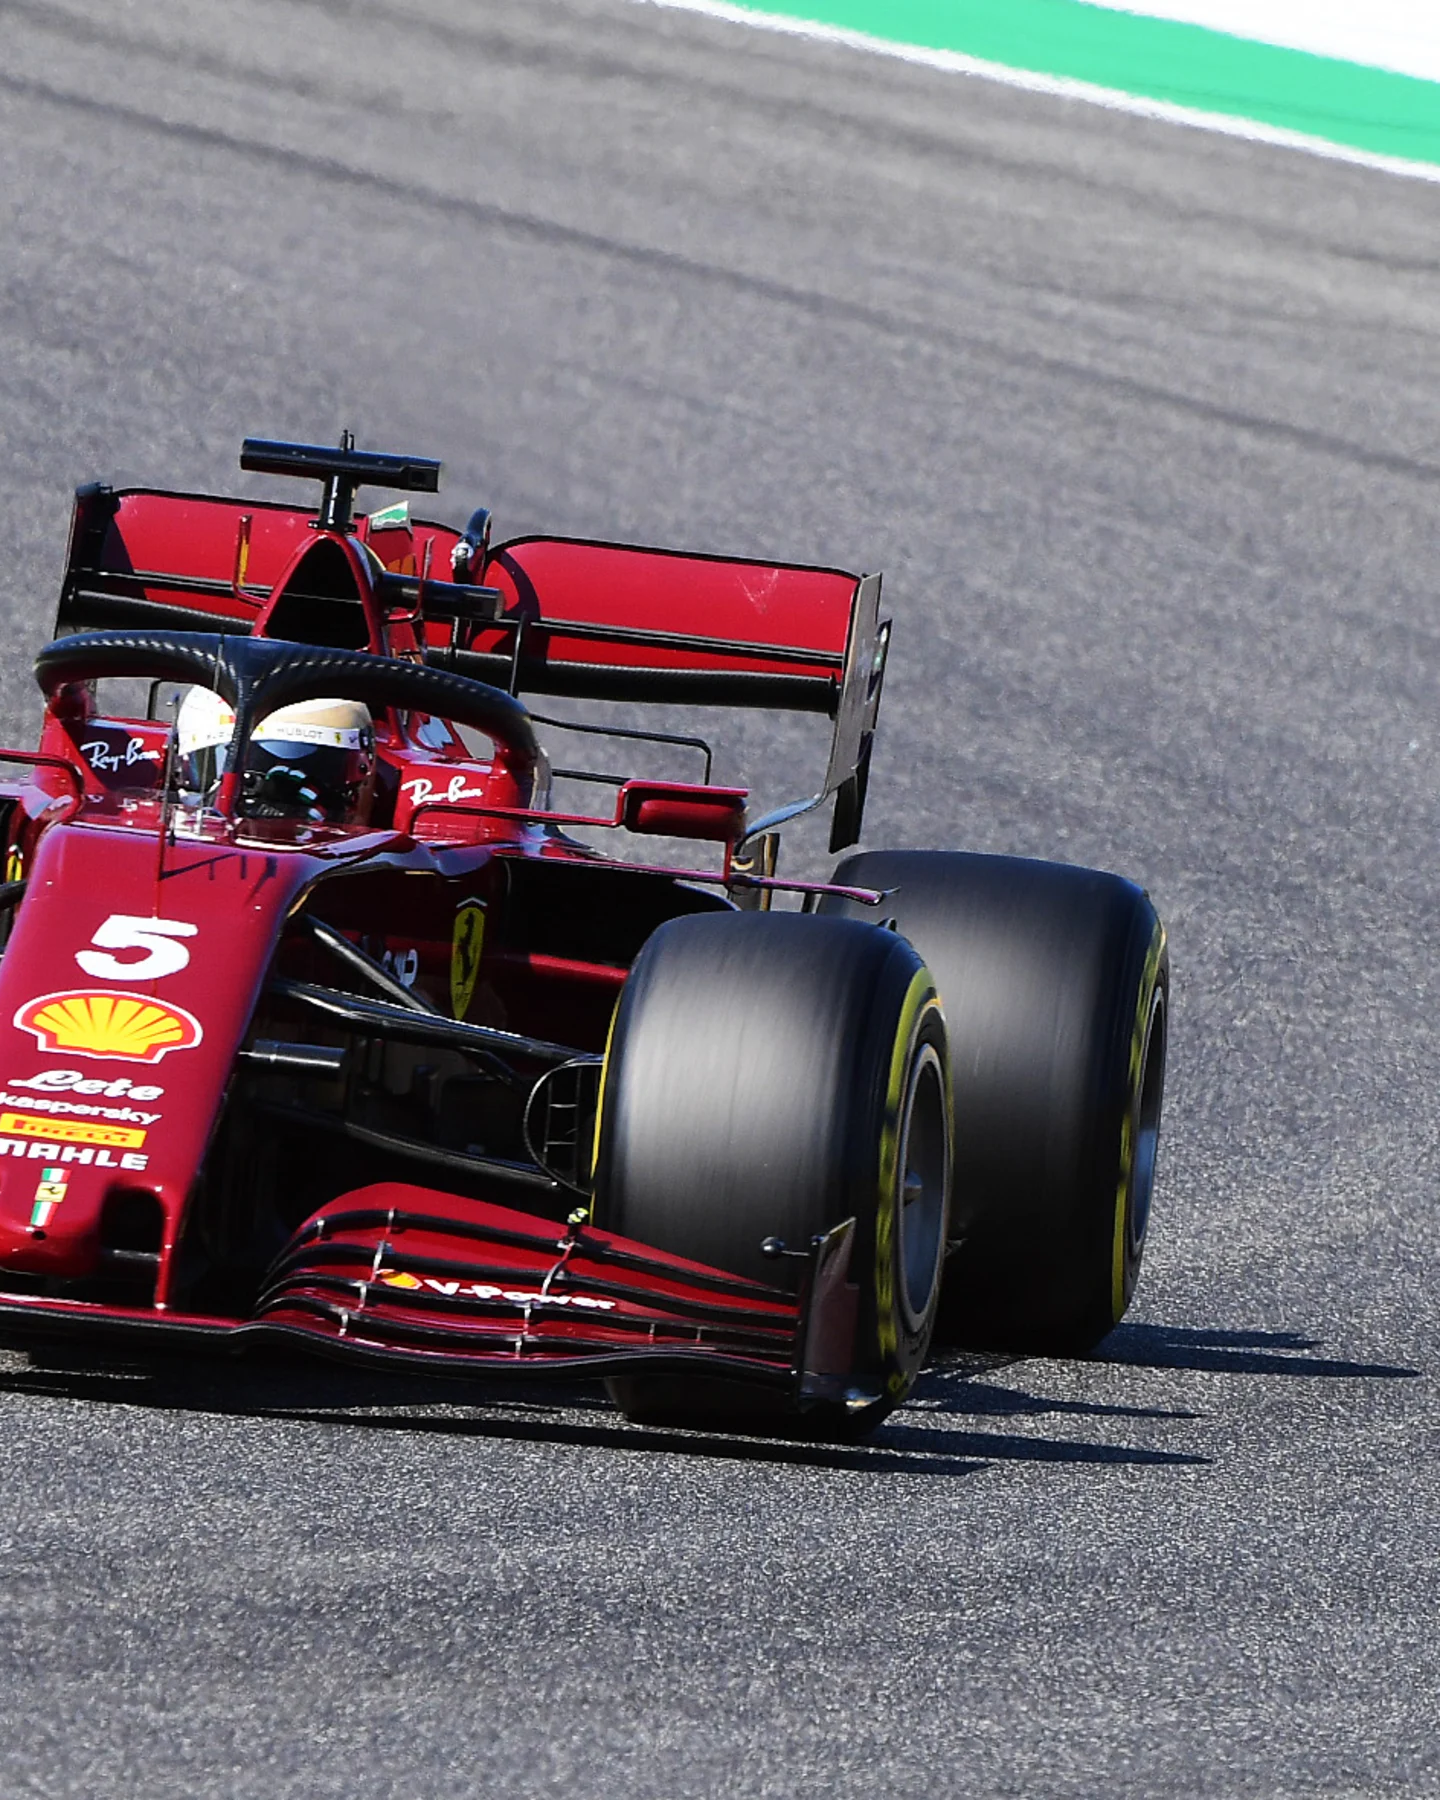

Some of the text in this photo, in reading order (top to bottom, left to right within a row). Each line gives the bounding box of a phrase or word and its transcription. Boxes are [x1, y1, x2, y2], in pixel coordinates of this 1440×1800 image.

[80, 737, 161, 772] Ray-Ban
[75, 914, 198, 981] 5
[423, 1278, 617, 1310] V-Power
